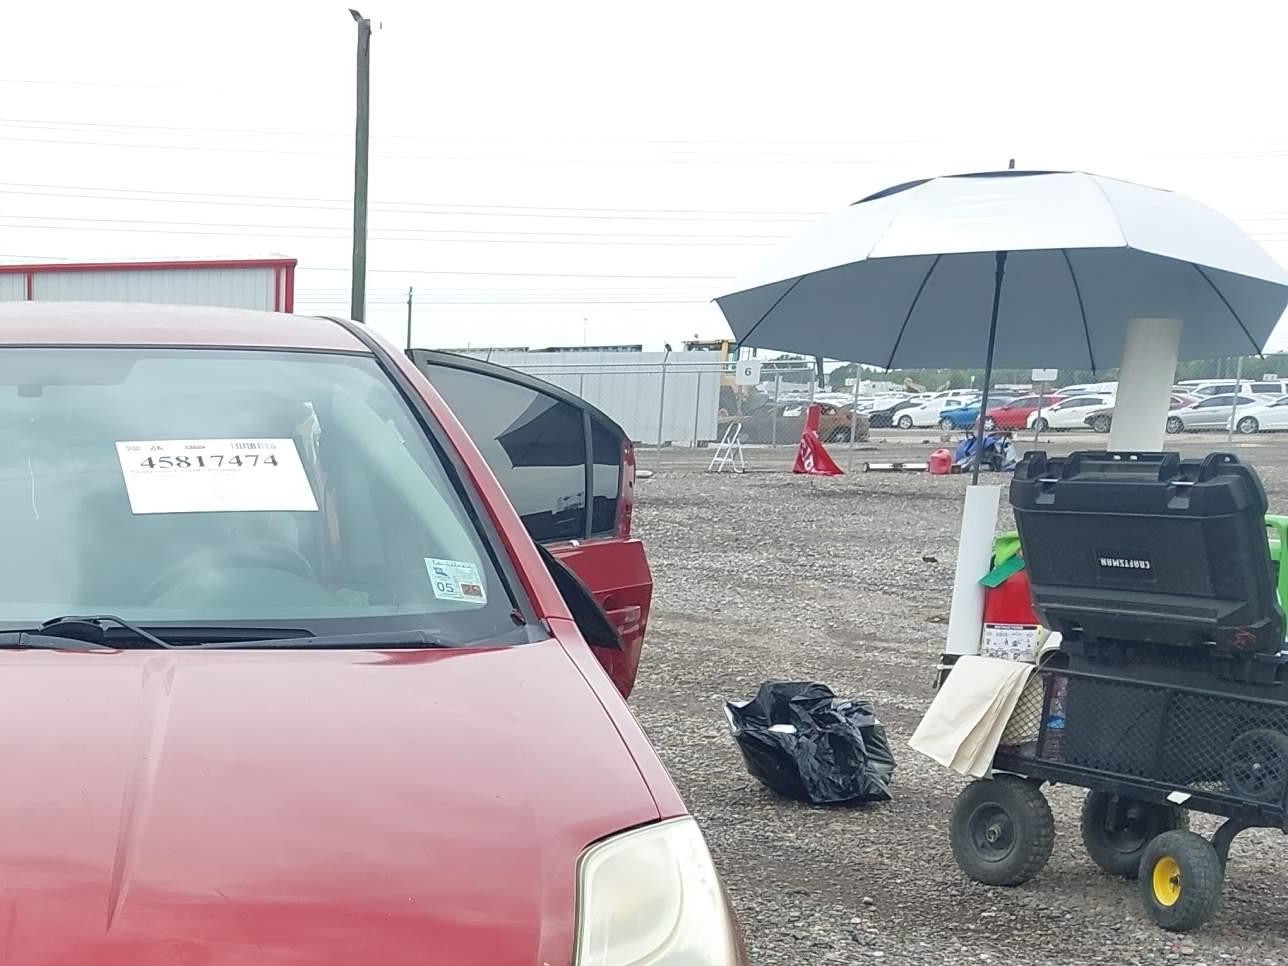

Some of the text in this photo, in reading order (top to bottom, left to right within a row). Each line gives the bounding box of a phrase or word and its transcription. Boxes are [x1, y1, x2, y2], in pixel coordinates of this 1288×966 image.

[744, 367, 752, 376] 6
[140, 454, 279, 469] 45817474
[1099, 558, 1151, 569] CRAFTSMAN
[436, 581, 455, 593] 05
